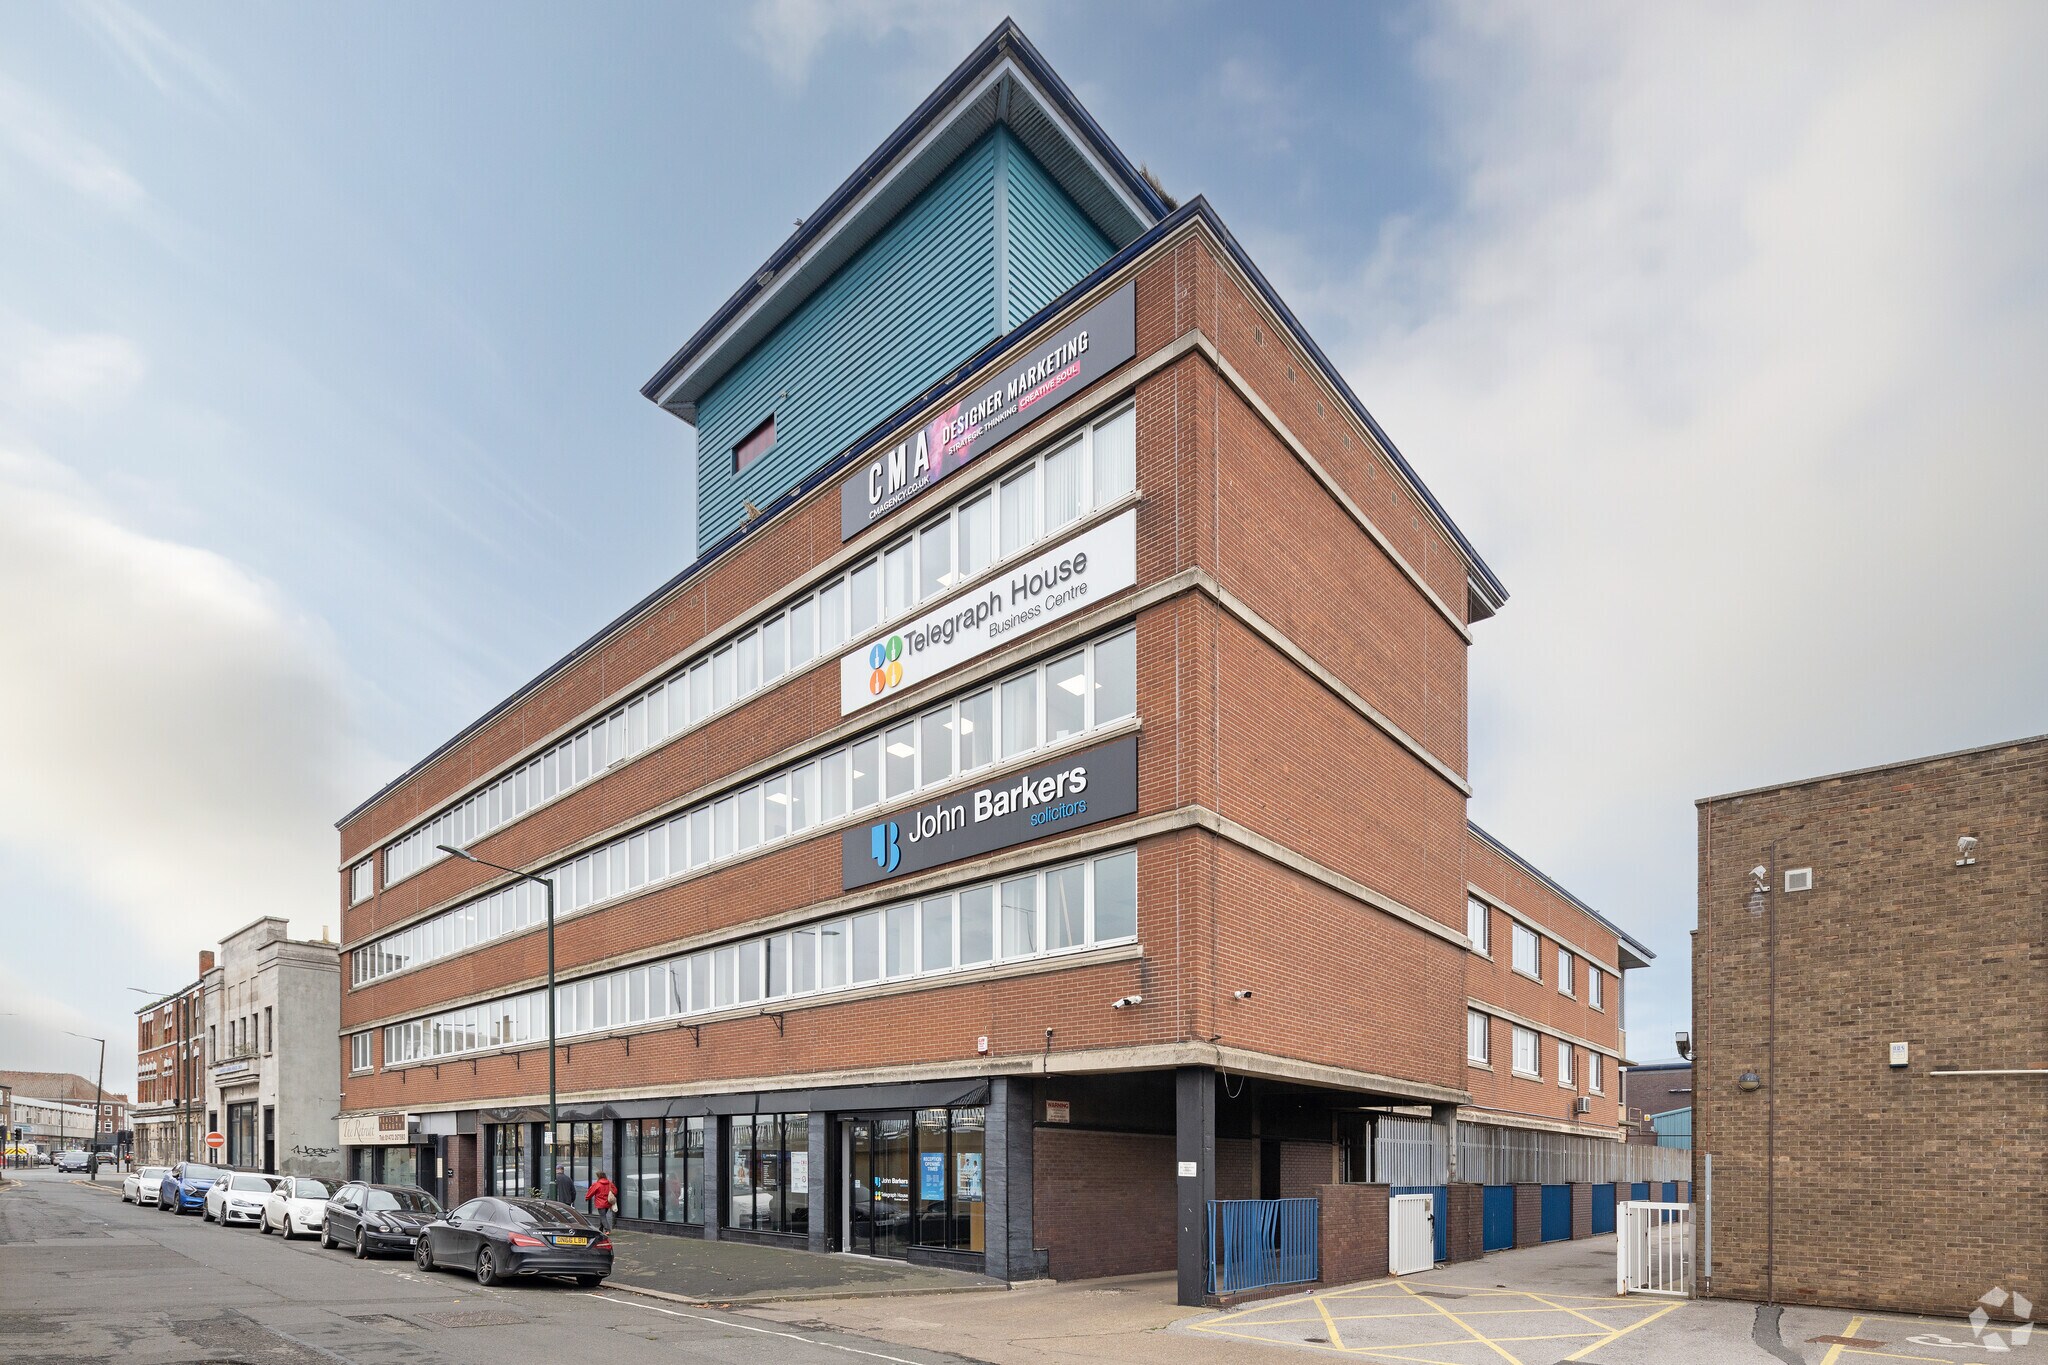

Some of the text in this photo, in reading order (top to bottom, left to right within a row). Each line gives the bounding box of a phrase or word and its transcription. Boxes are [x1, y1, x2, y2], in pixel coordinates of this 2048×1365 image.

[942, 331, 1089, 445] DESIGNER MARKETING
[948, 365, 1078, 455] STRATEGIC THINKING CREATIVE SOUL
[868, 474, 931, 520] CMAGENCY.CO.UK
[869, 429, 930, 505] CMA
[904, 551, 1088, 655] Telegraph House
[989, 581, 1088, 638] Business Centre
[908, 766, 1088, 843] John Barkers
[1030, 799, 1087, 827] solicitors
[891, 1177, 909, 1185] Barkers
